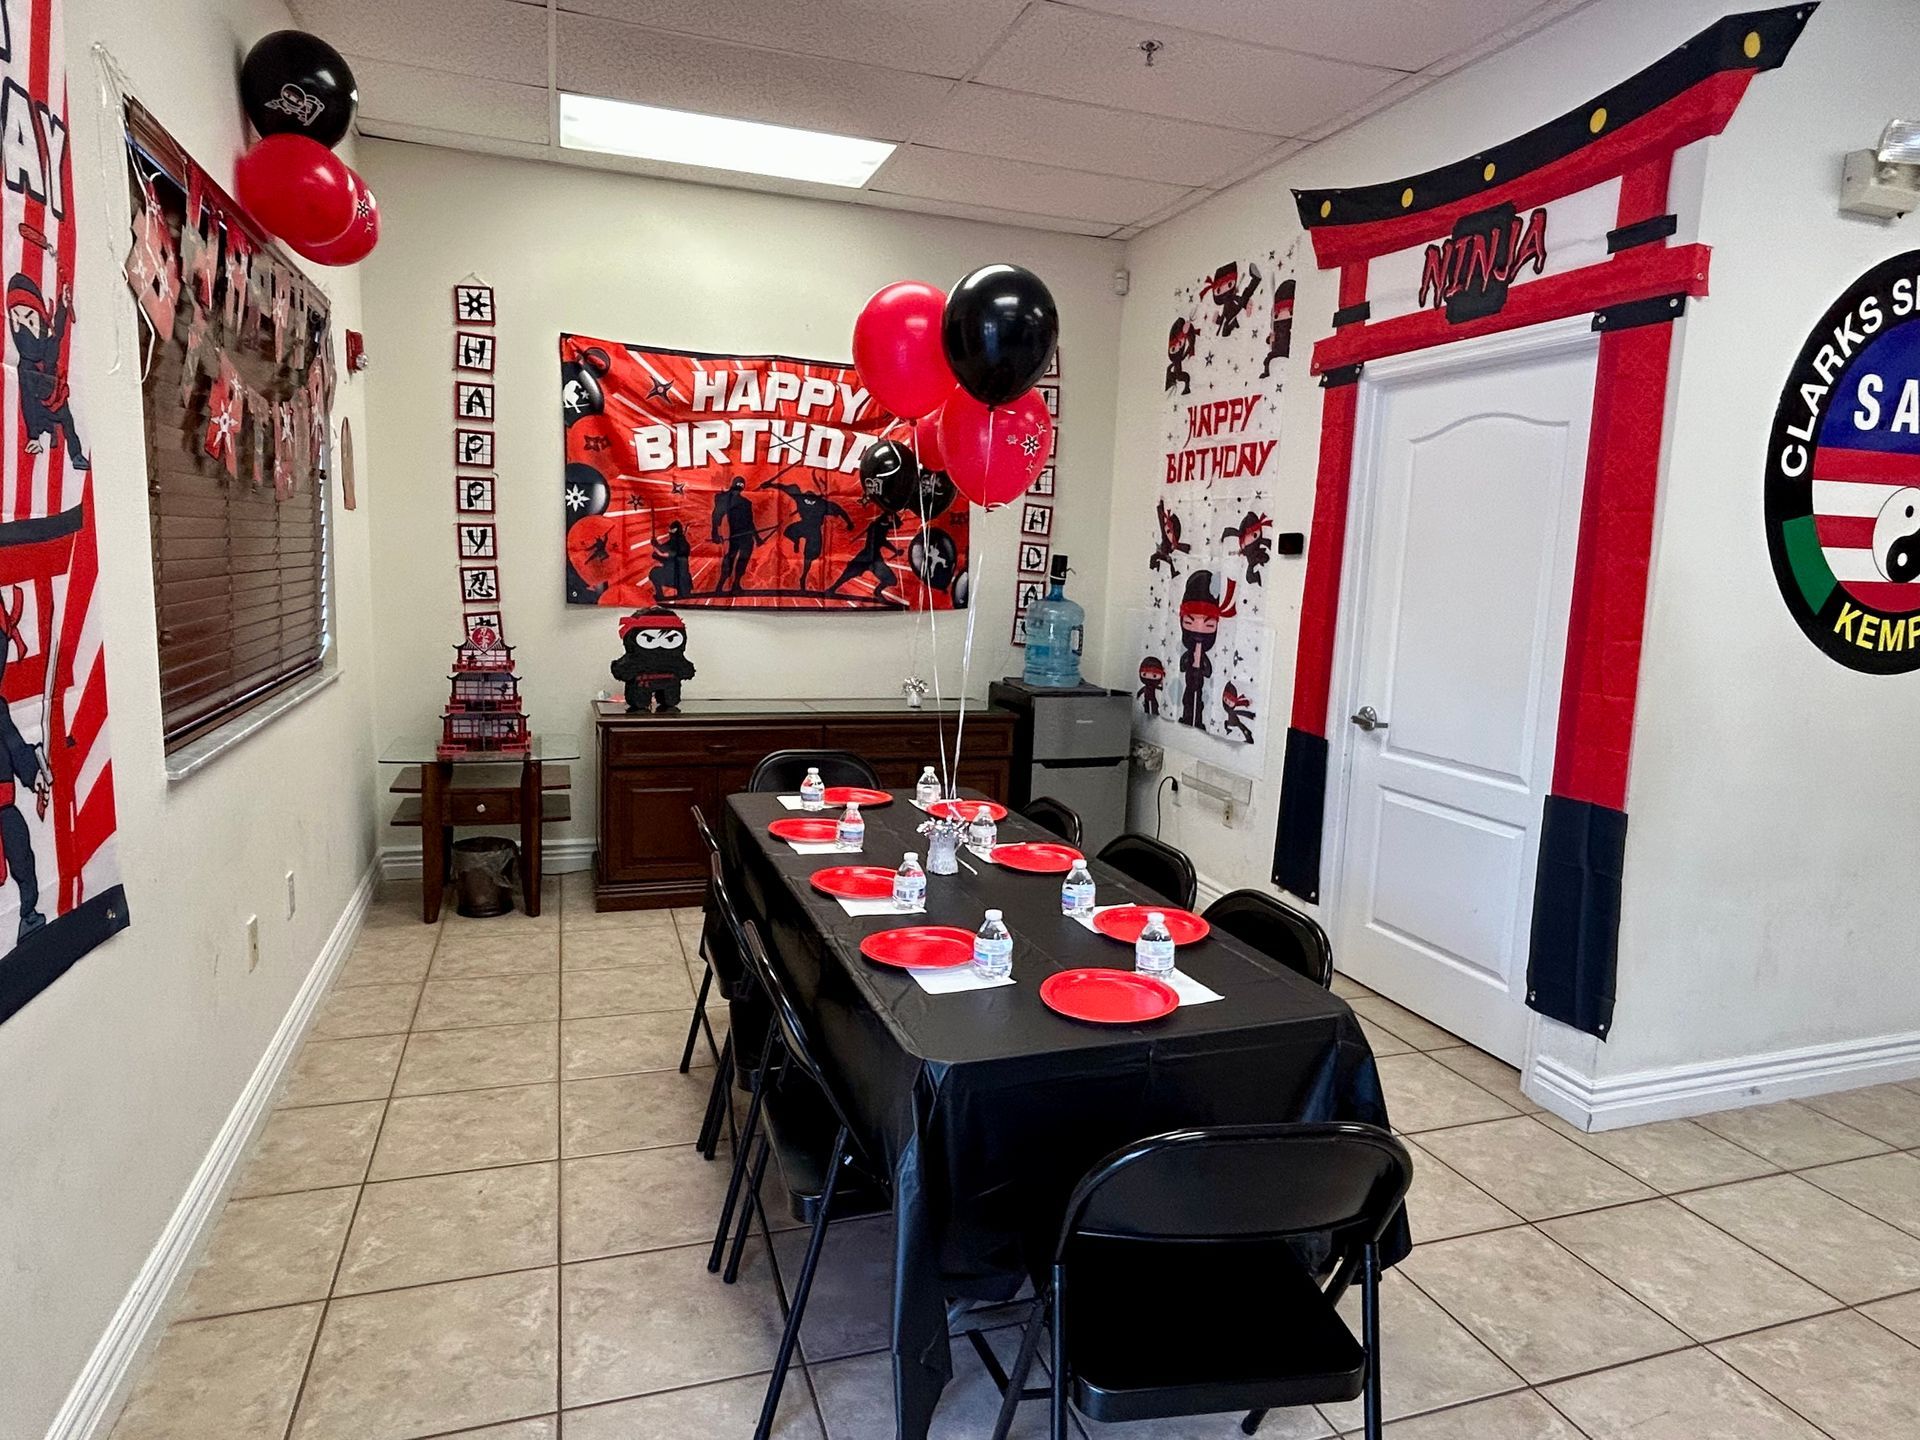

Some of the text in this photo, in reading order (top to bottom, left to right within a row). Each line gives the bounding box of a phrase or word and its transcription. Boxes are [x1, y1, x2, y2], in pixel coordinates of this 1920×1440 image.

[1419, 208, 1547, 309] NINJA
[692, 369, 870, 425] HAPPY
[1781, 275, 1920, 478] CLARKS S
[632, 418, 879, 474] BIRTHDA
[1183, 394, 1263, 449] HAPPY
[1166, 440, 1278, 489] BIRTHDAY
